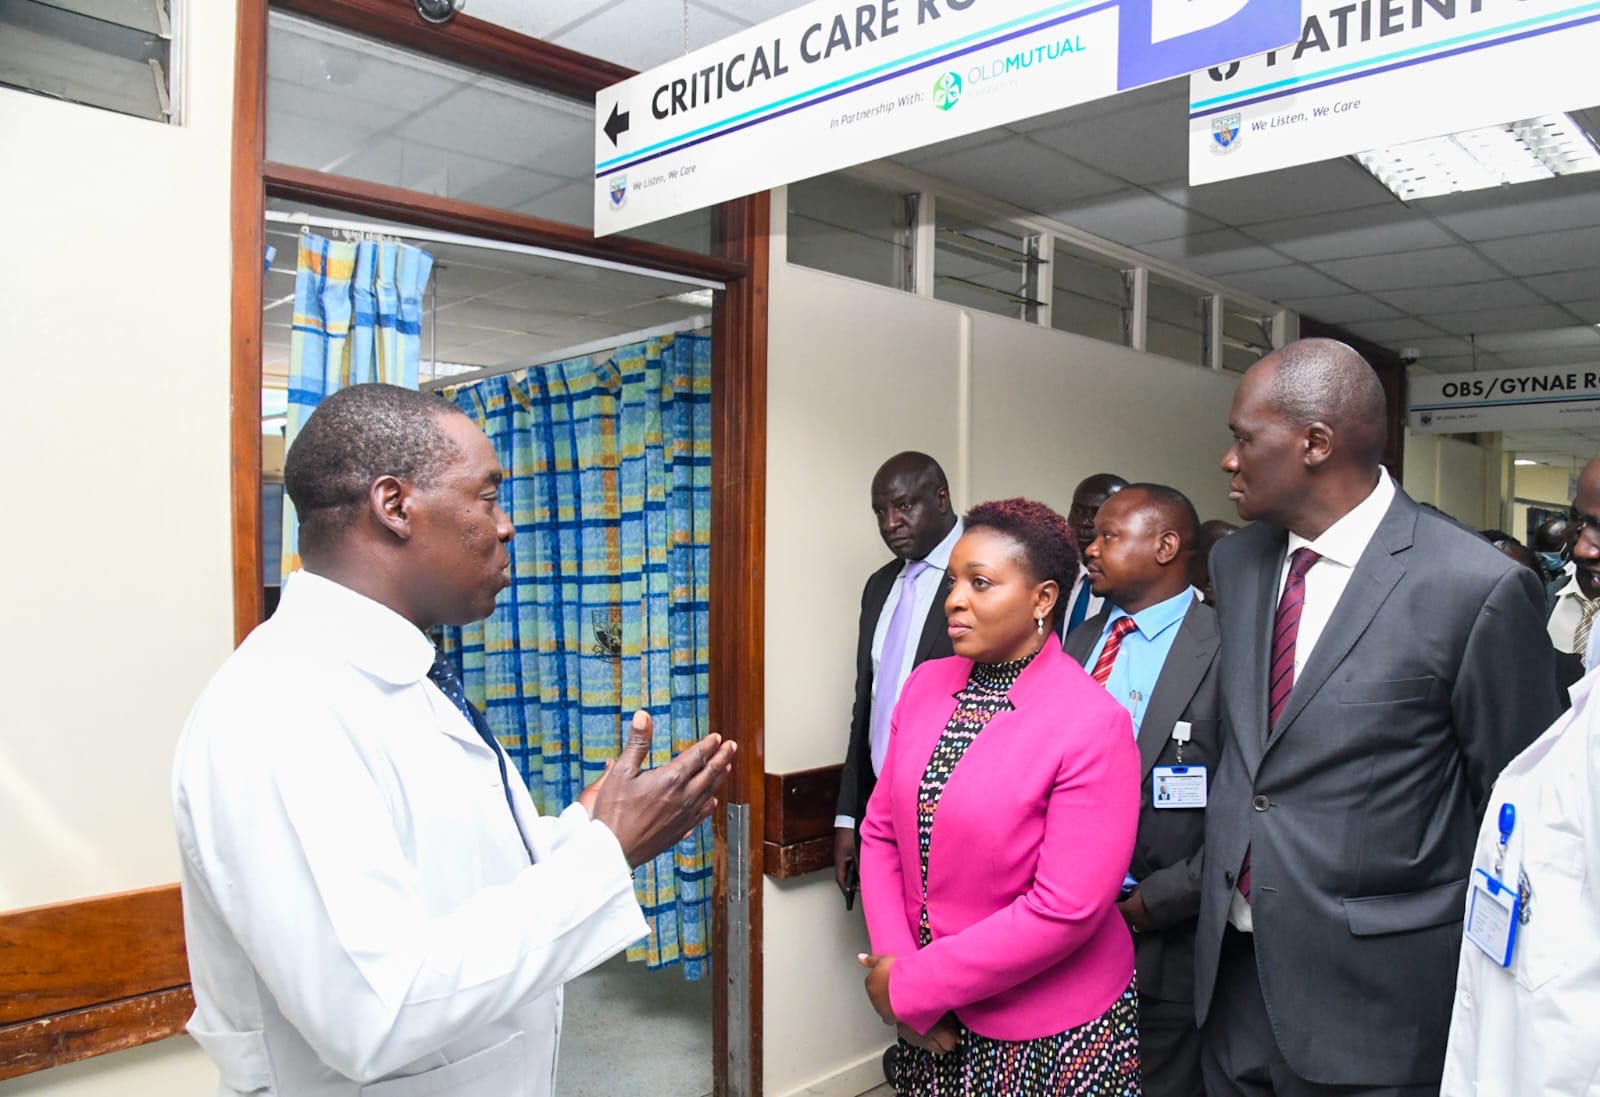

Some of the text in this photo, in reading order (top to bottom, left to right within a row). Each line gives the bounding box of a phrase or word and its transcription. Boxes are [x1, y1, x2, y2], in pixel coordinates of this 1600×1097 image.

[1265, 0, 1482, 67] ATIEN
[651, 38, 789, 120] CRITICAL
[800, 0, 899, 64] CARE
[830, 91, 925, 129] In Partnership With:
[1251, 100, 1361, 131] We Listen, We Care
[633, 182, 642, 192] We
[668, 169, 679, 179] We
[680, 164, 697, 177] Care
[1442, 372, 1600, 399] OBS/GYNAE R
